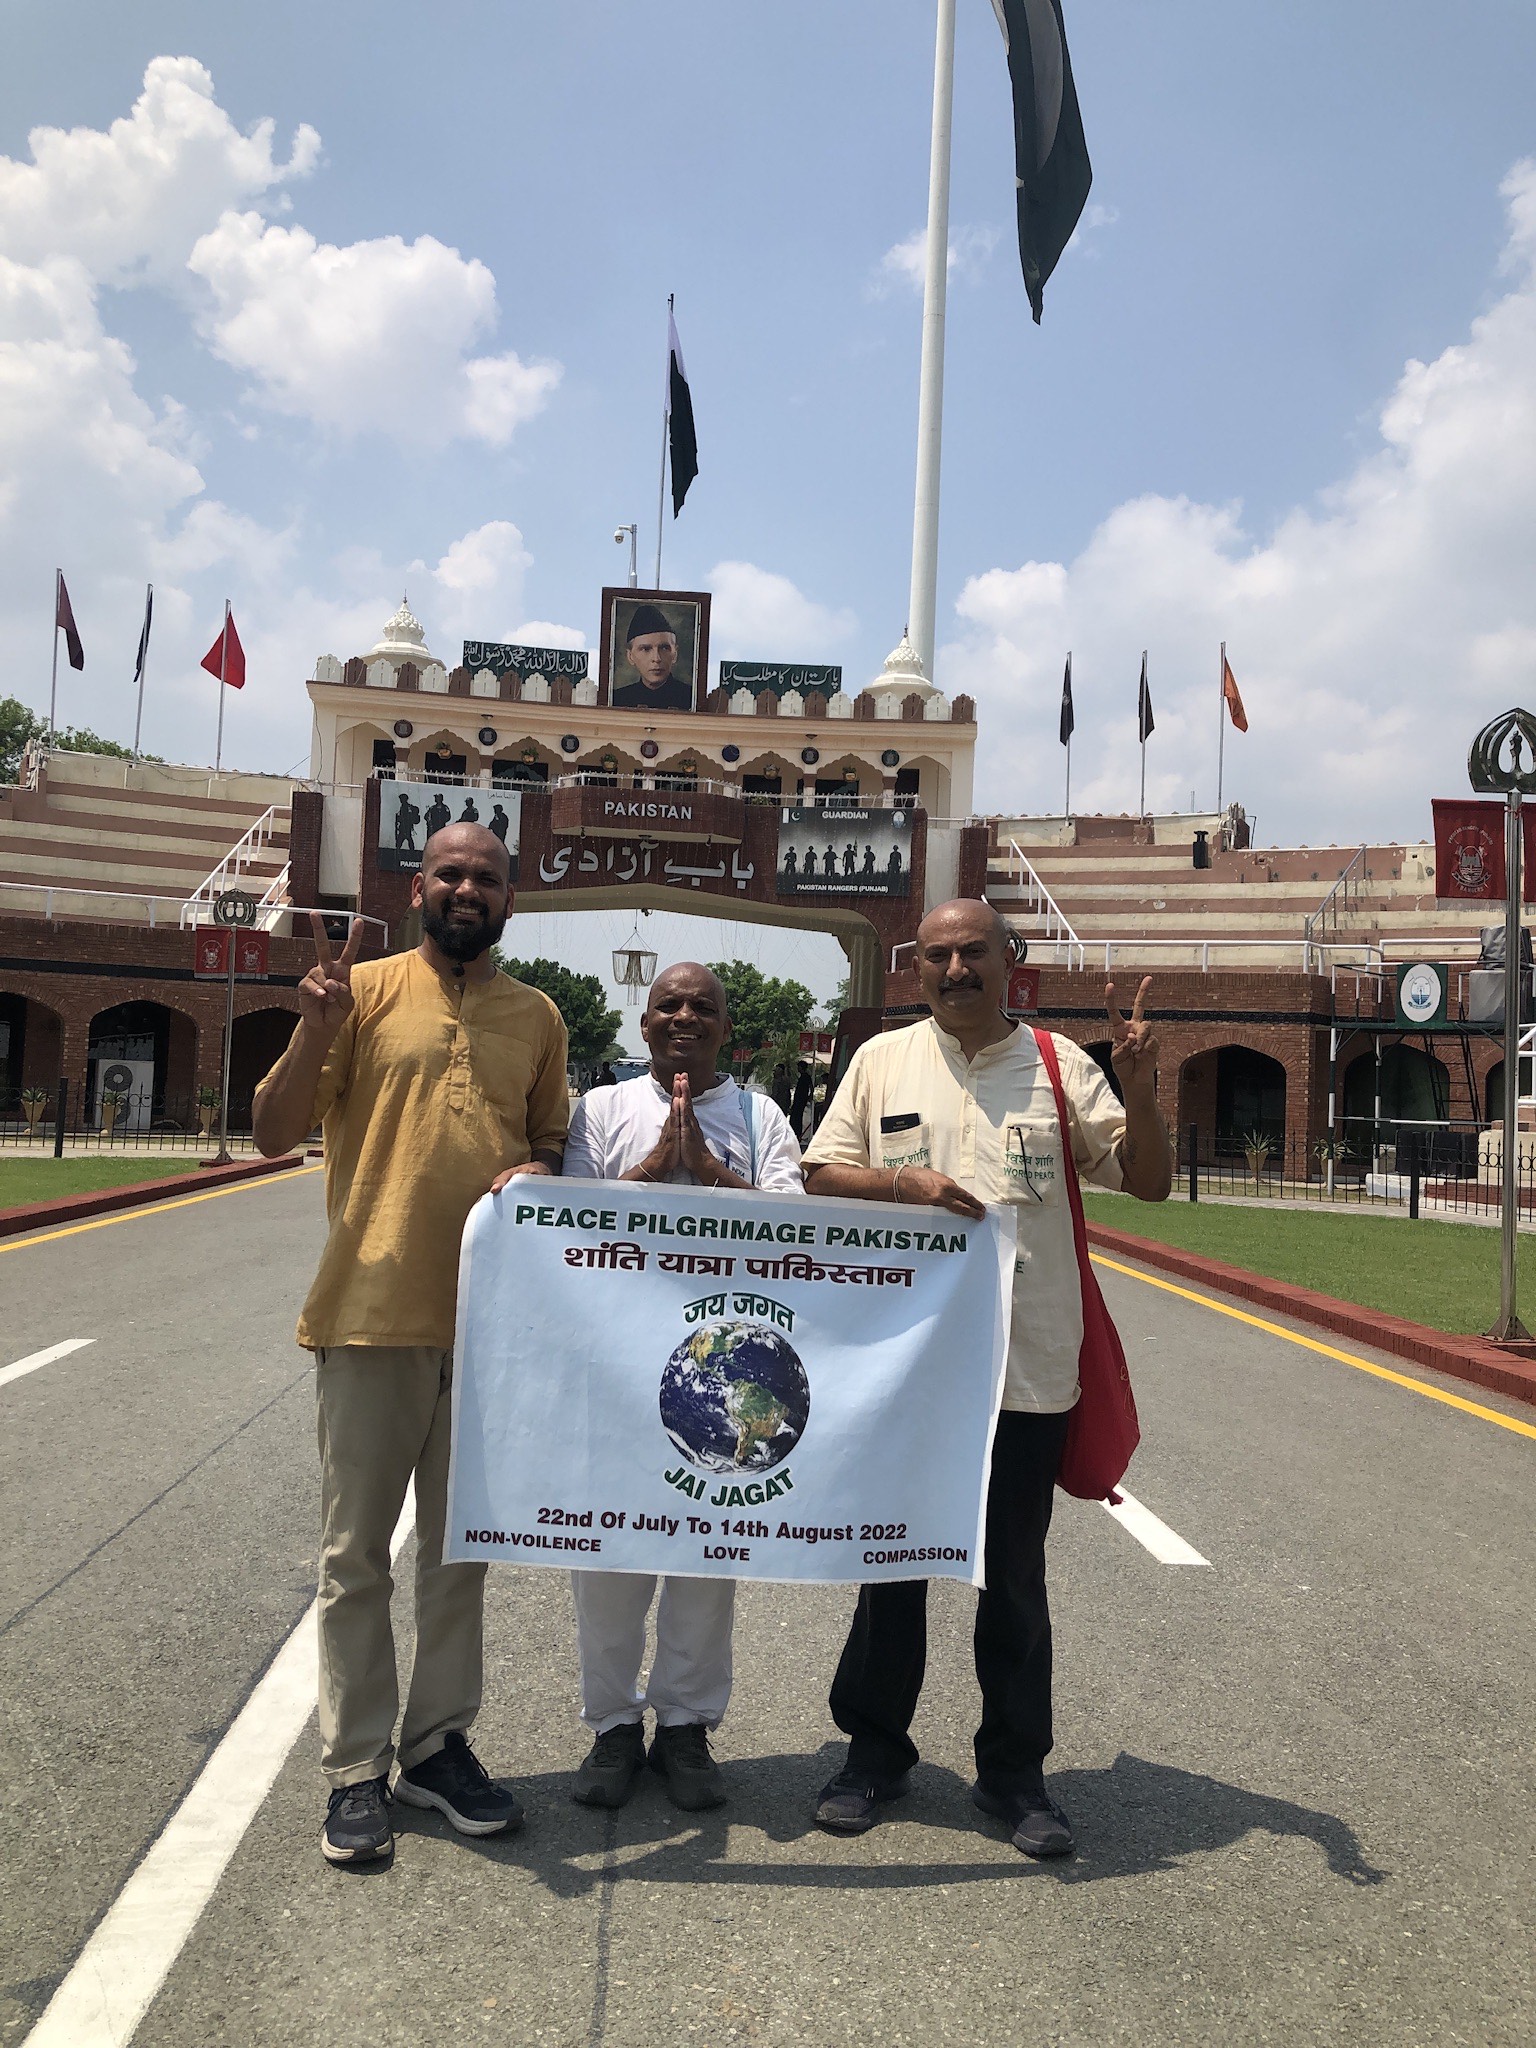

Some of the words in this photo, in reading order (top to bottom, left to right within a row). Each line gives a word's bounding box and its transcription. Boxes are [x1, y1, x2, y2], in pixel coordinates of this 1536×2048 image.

[604, 800, 692, 820] PAKISTAN
[821, 810, 869, 820] GUARDIAN
[400, 860, 422, 869] PAKIST
[539, 840, 660, 883] آزادی
[796, 883, 827, 892] PAKISTAN
[827, 884, 859, 893] RANGERS
[859, 884, 889, 894] (PUNJAB)
[1034, 1171, 1055, 1180] PEACE
[515, 1204, 617, 1231] PEACE
[627, 1212, 816, 1244] PILGRIMAGE
[825, 1226, 967, 1253] PAKISTAN
[563, 1241, 649, 1271] शांति
[657, 1252, 736, 1277] यात्रा
[744, 1252, 915, 1288] पाकिस्तान
[683, 1292, 728, 1323] जय
[732, 1292, 796, 1333] जगत
[664, 1466, 707, 1501] JAI
[710, 1467, 794, 1507] JAGAT
[537, 1507, 593, 1528] 22nd
[600, 1511, 626, 1529] Of
[632, 1513, 680, 1537] July
[686, 1516, 712, 1535] To
[720, 1519, 769, 1538] 14th
[776, 1522, 853, 1544] August
[859, 1523, 907, 1541] 2022
[465, 1529, 602, 1552] NON-VOILENCE
[703, 1545, 750, 1561] LOVE
[863, 1547, 967, 1565] COMPASSION
